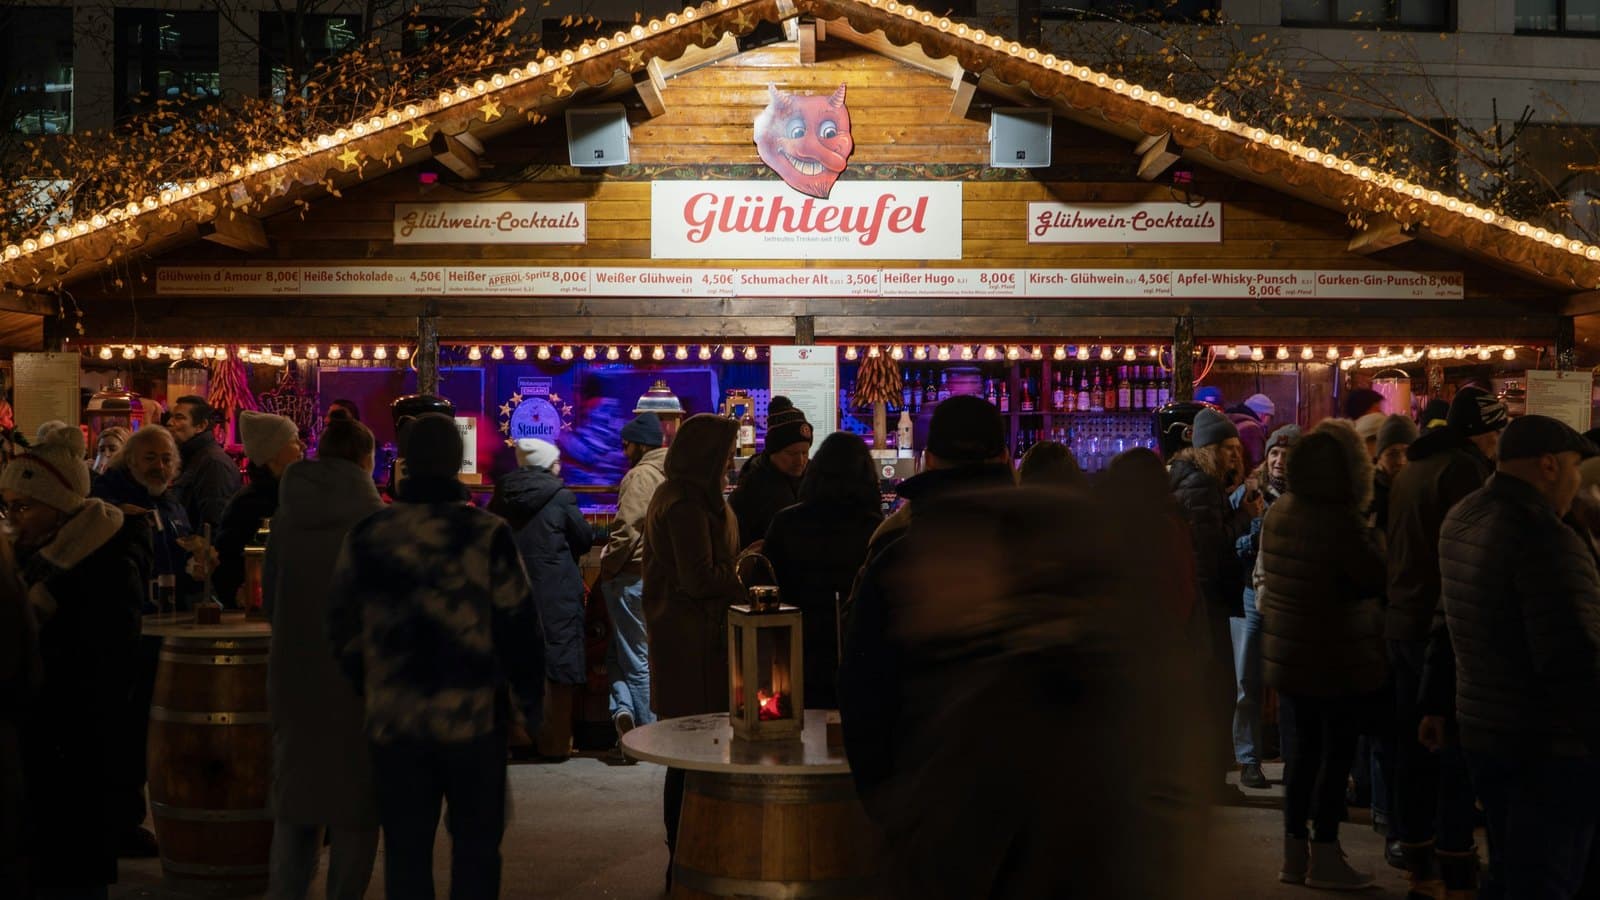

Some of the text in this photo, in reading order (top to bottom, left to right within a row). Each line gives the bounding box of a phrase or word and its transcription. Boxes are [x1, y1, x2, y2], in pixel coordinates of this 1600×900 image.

[400, 211, 580, 237] Glühwein-Cocktails
[684, 192, 929, 246] Glühteufel
[1035, 210, 1216, 237] Glühwein-Cocktails
[158, 270, 211, 281] Glühwein
[265, 271, 299, 284] 8,00€
[304, 270, 333, 281] Heiße
[335, 270, 393, 282] Schokolade
[409, 271, 441, 283] 4,50€
[448, 271, 486, 282] Heißer
[551, 272, 587, 283] 8,00€
[596, 272, 733, 285] Weißer Glühwein 4,50€
[740, 273, 810, 285] Schumacher
[812, 274, 829, 285] Alt
[847, 274, 878, 286] 3,50€
[883, 273, 921, 284] Heißer
[924, 273, 955, 286] Hugo
[980, 273, 1015, 285] 8,00€
[1070, 273, 1124, 284] Glühwein
[1138, 273, 1169, 285] 4,50€
[1177, 273, 1297, 287] Apfel-Whisky-Punsch
[1317, 274, 1427, 286] Gurken-Gin-Punsch
[1428, 275, 1462, 288] 8,00€
[1248, 285, 1281, 297] 8,00€
[517, 423, 554, 436] Stauder
